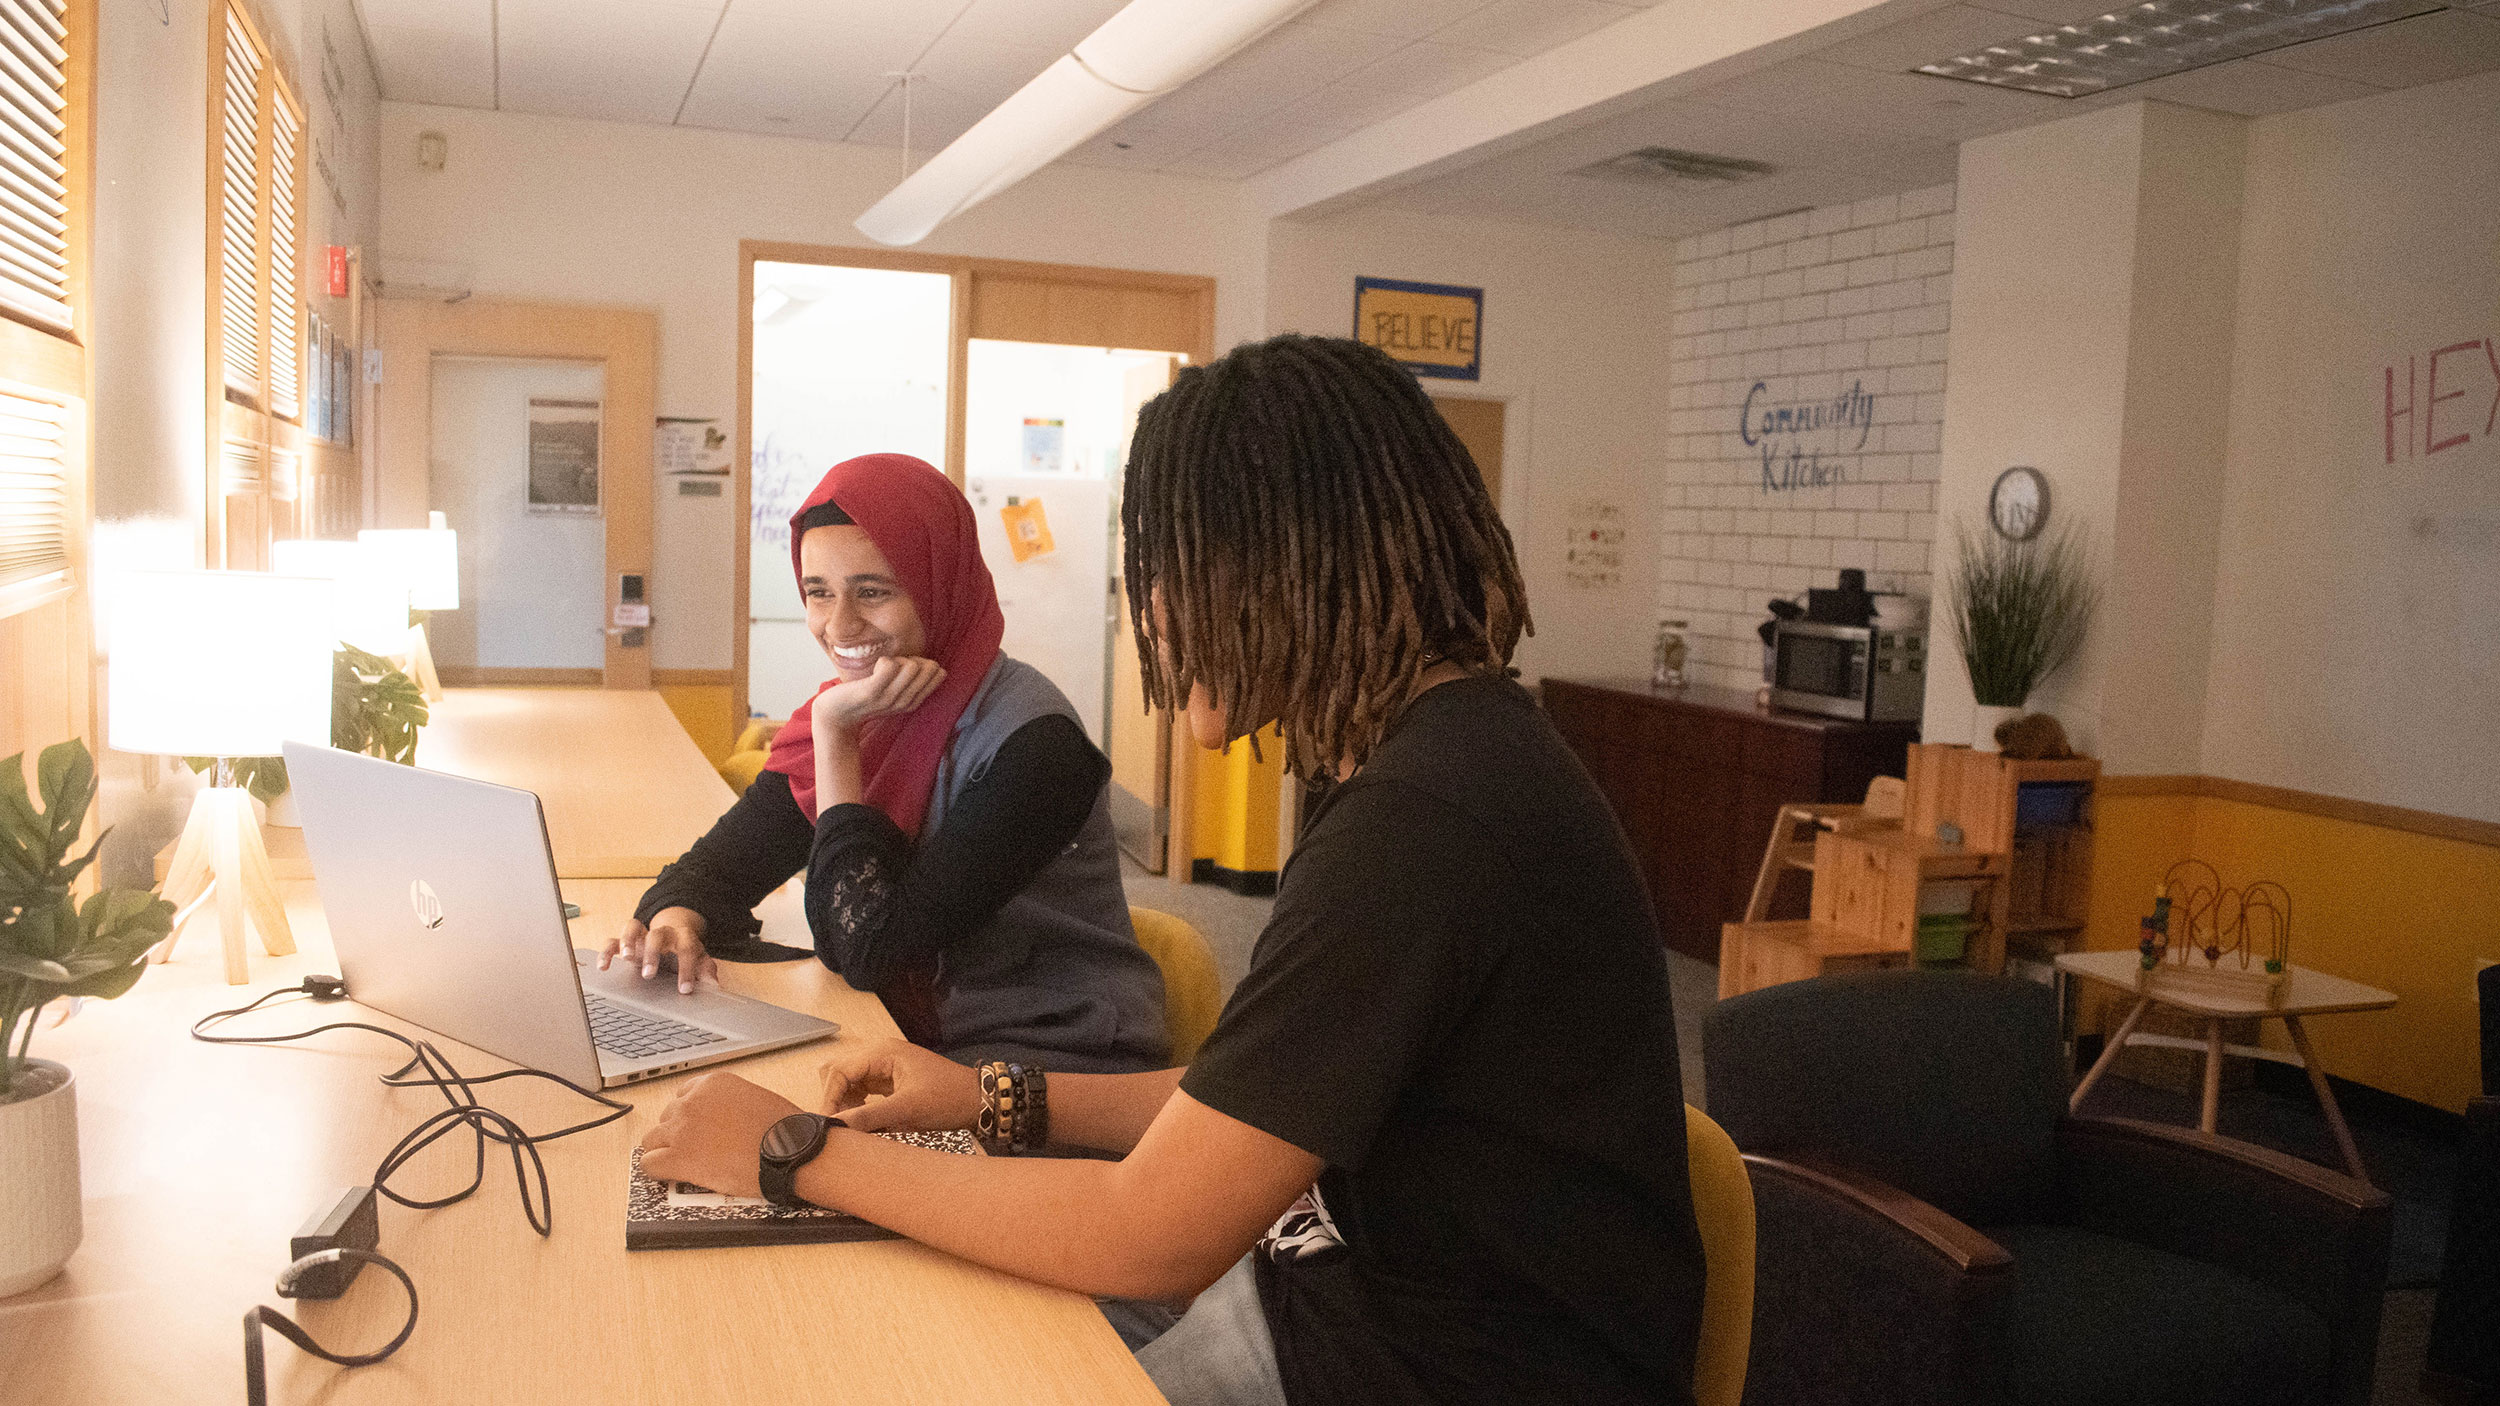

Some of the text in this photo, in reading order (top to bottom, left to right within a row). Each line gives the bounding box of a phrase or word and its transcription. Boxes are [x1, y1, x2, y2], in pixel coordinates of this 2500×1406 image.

[1371, 311, 1473, 353] BELIEVE
[1740, 379, 1874, 450] Community
[1761, 443, 1846, 495] Kitchen
[413, 879, 440, 930] hp
